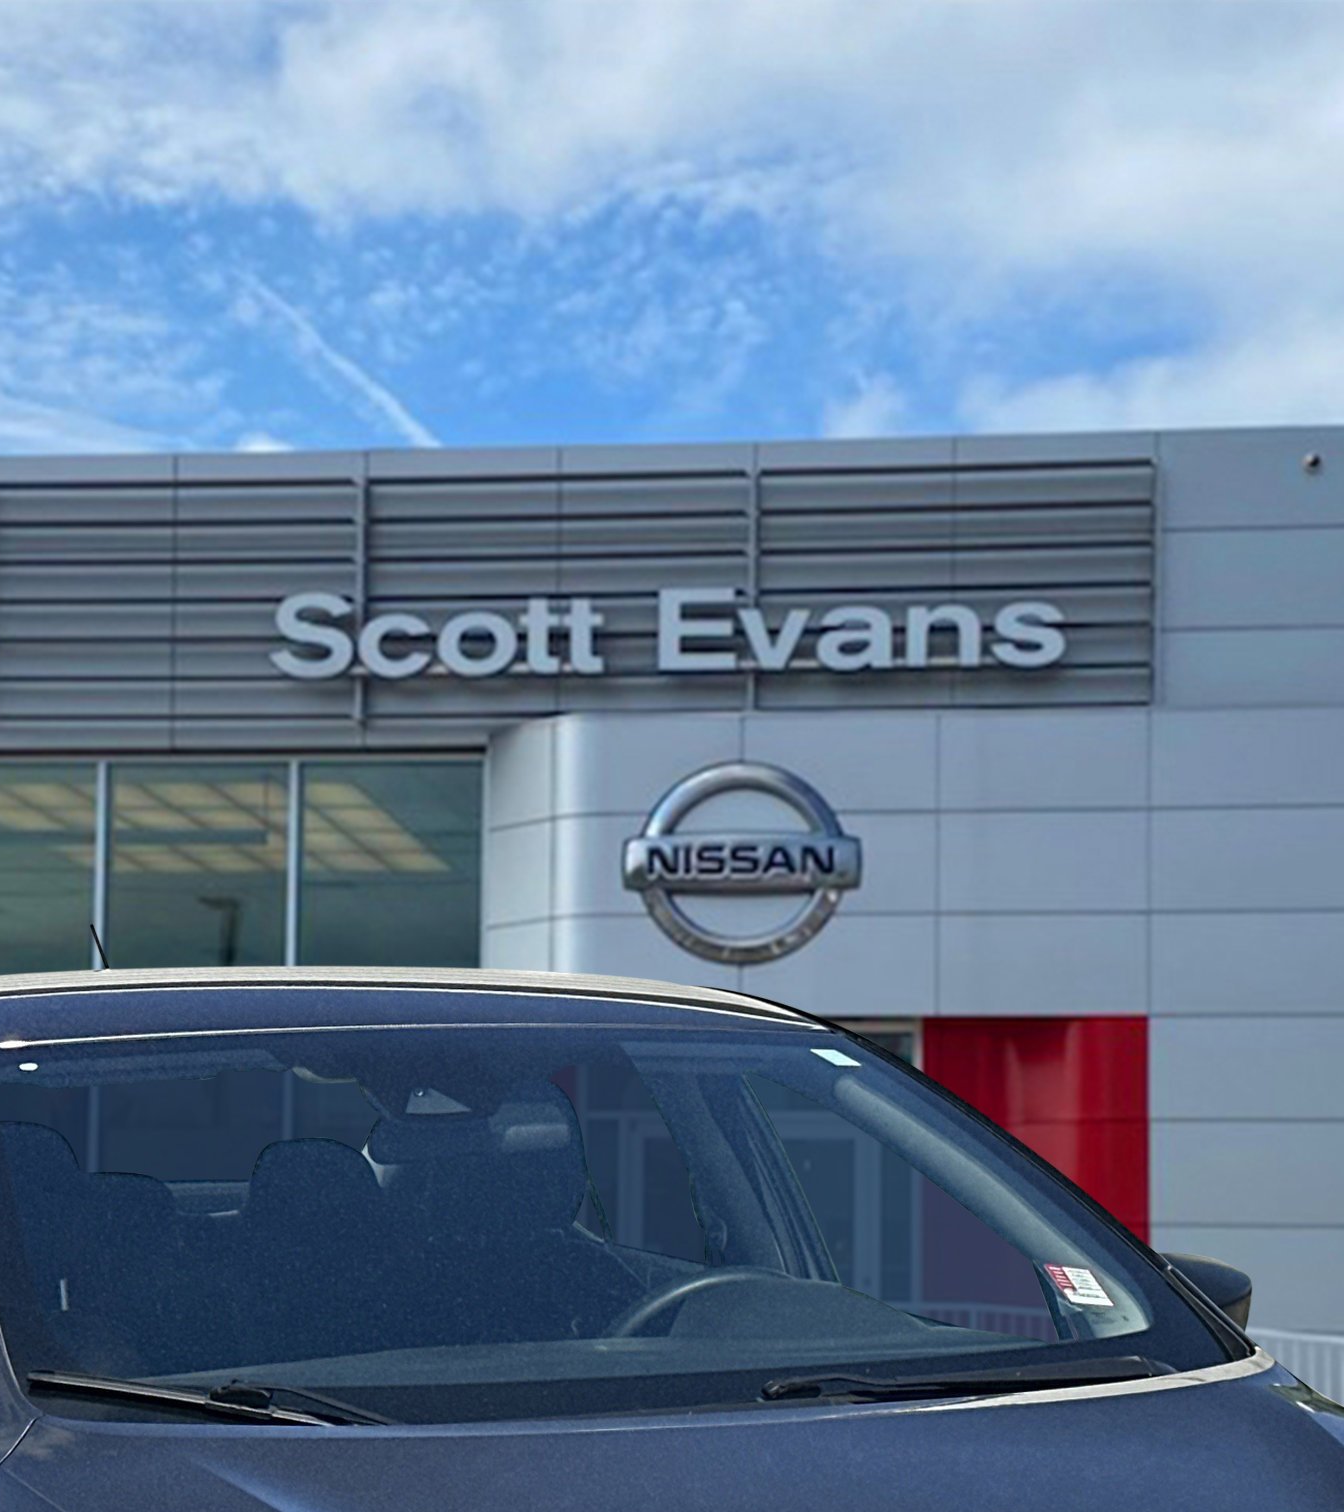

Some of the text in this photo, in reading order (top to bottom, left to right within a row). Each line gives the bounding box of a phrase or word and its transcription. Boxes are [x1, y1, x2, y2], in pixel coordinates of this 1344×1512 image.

[268, 588, 1067, 680] Scott Evans
[647, 844, 835, 876] NISSAN
